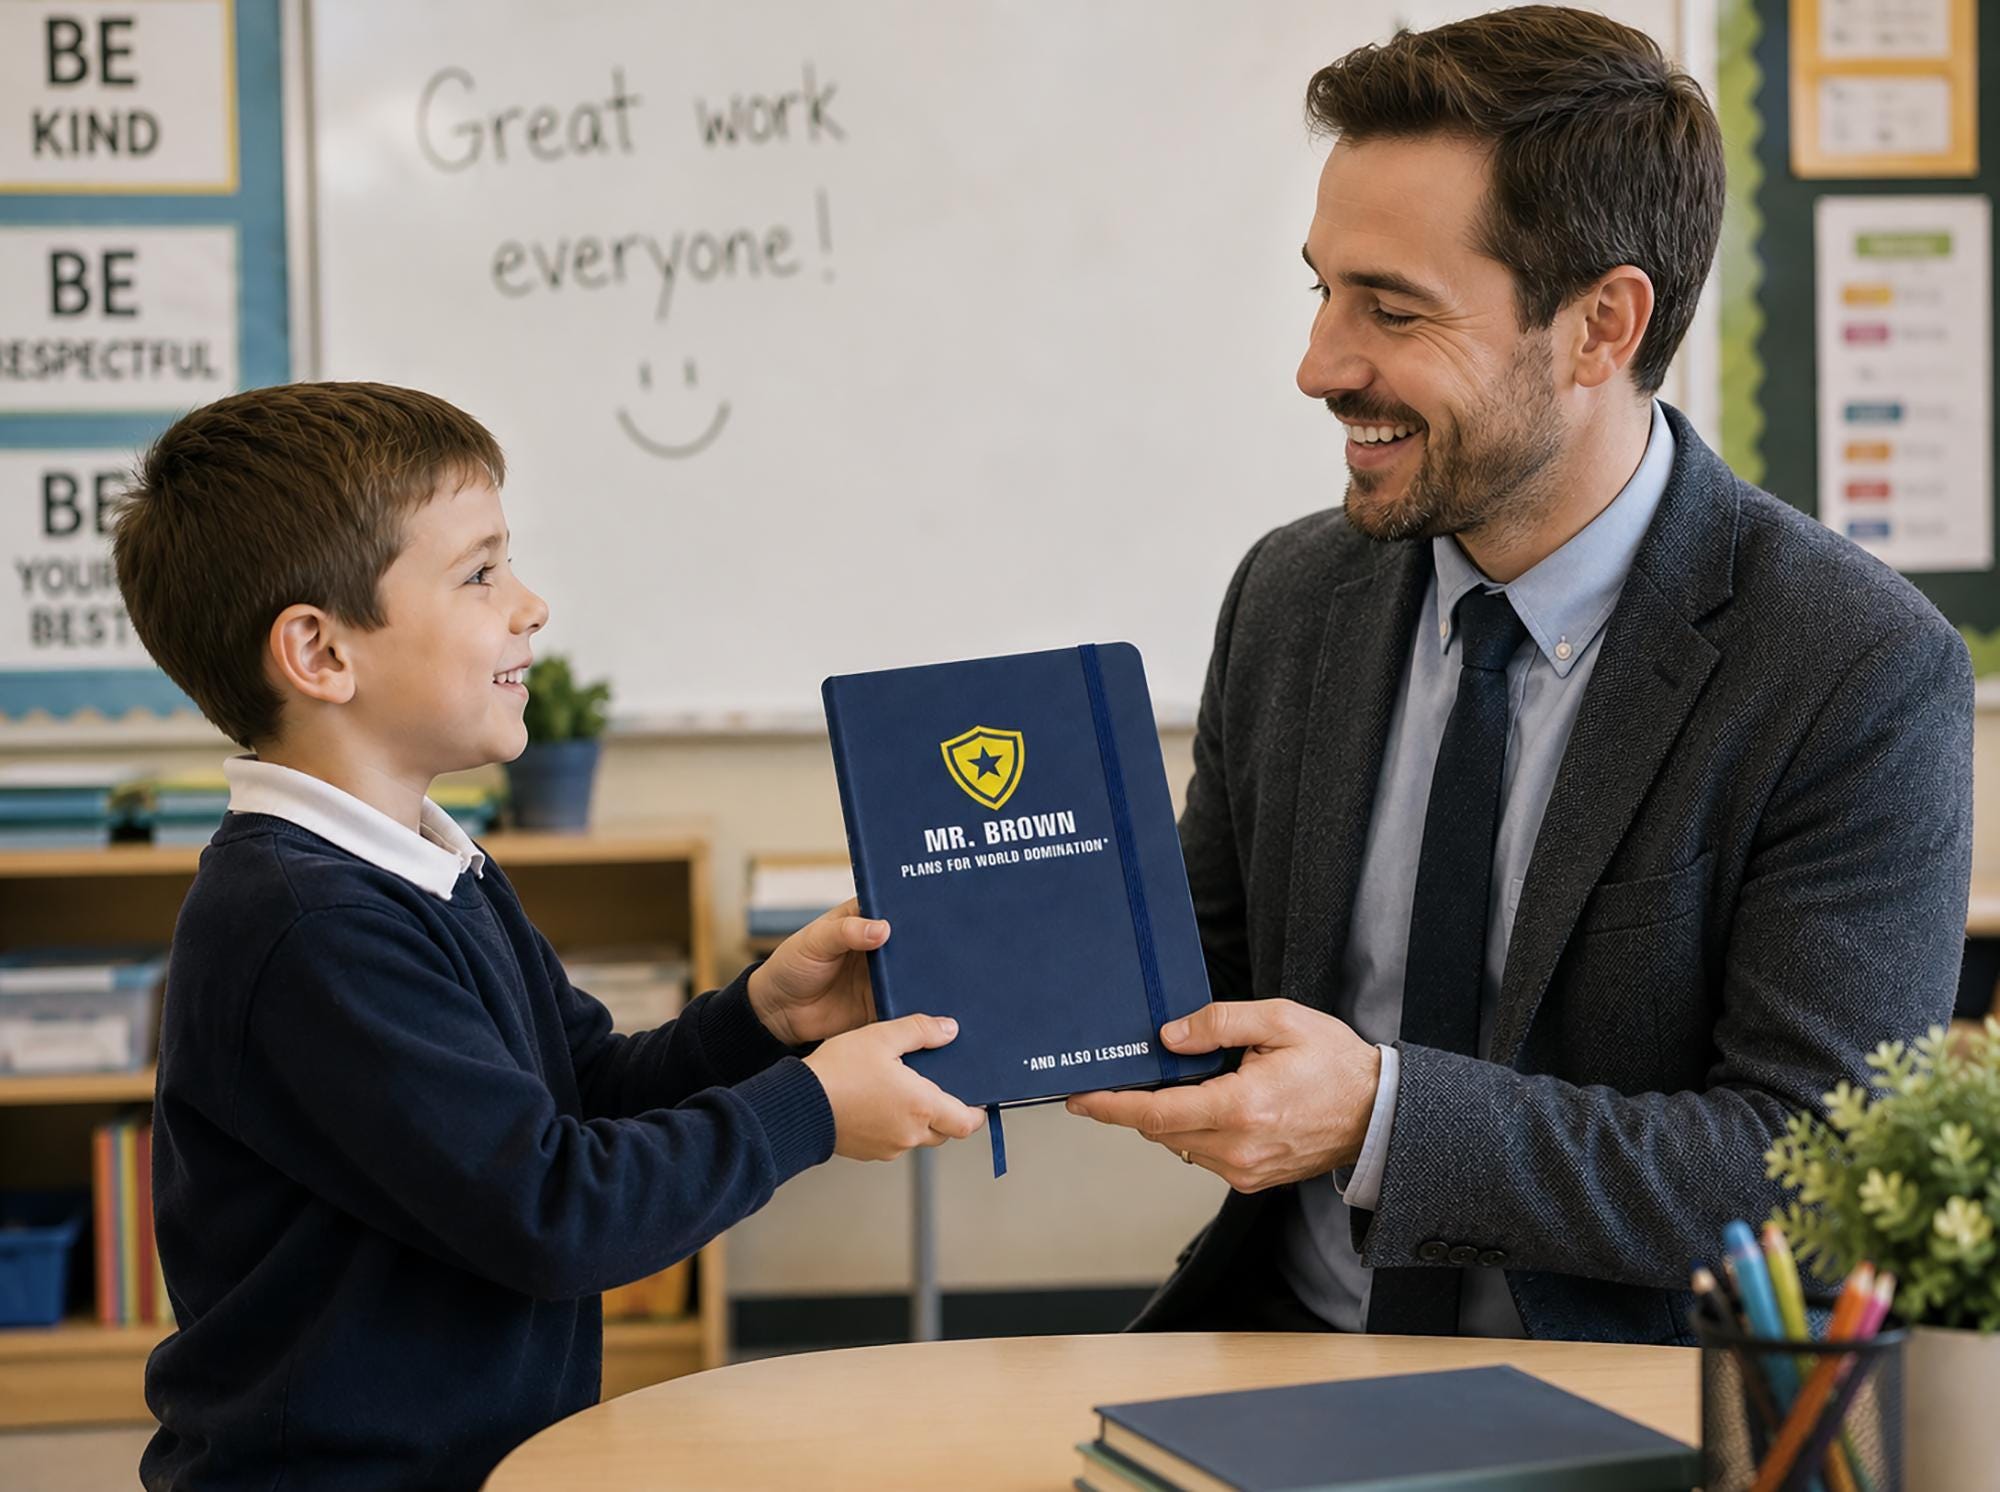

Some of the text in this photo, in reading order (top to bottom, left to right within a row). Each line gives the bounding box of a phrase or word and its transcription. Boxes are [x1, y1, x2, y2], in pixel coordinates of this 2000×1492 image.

[44, 17, 138, 87] BE
[31, 109, 161, 157] KIND
[416, 60, 847, 174] Great work
[492, 188, 836, 321] everyone!
[48, 249, 138, 317] BE
[31, 606, 132, 646] BEST
[924, 810, 1076, 853] MR. BROWN
[901, 860, 943, 878] PLANS
[947, 856, 972, 872] FOR
[975, 849, 1020, 868] WORLD
[1060, 1049, 1092, 1067] ALSO
[1095, 1041, 1149, 1061] LESSONS
